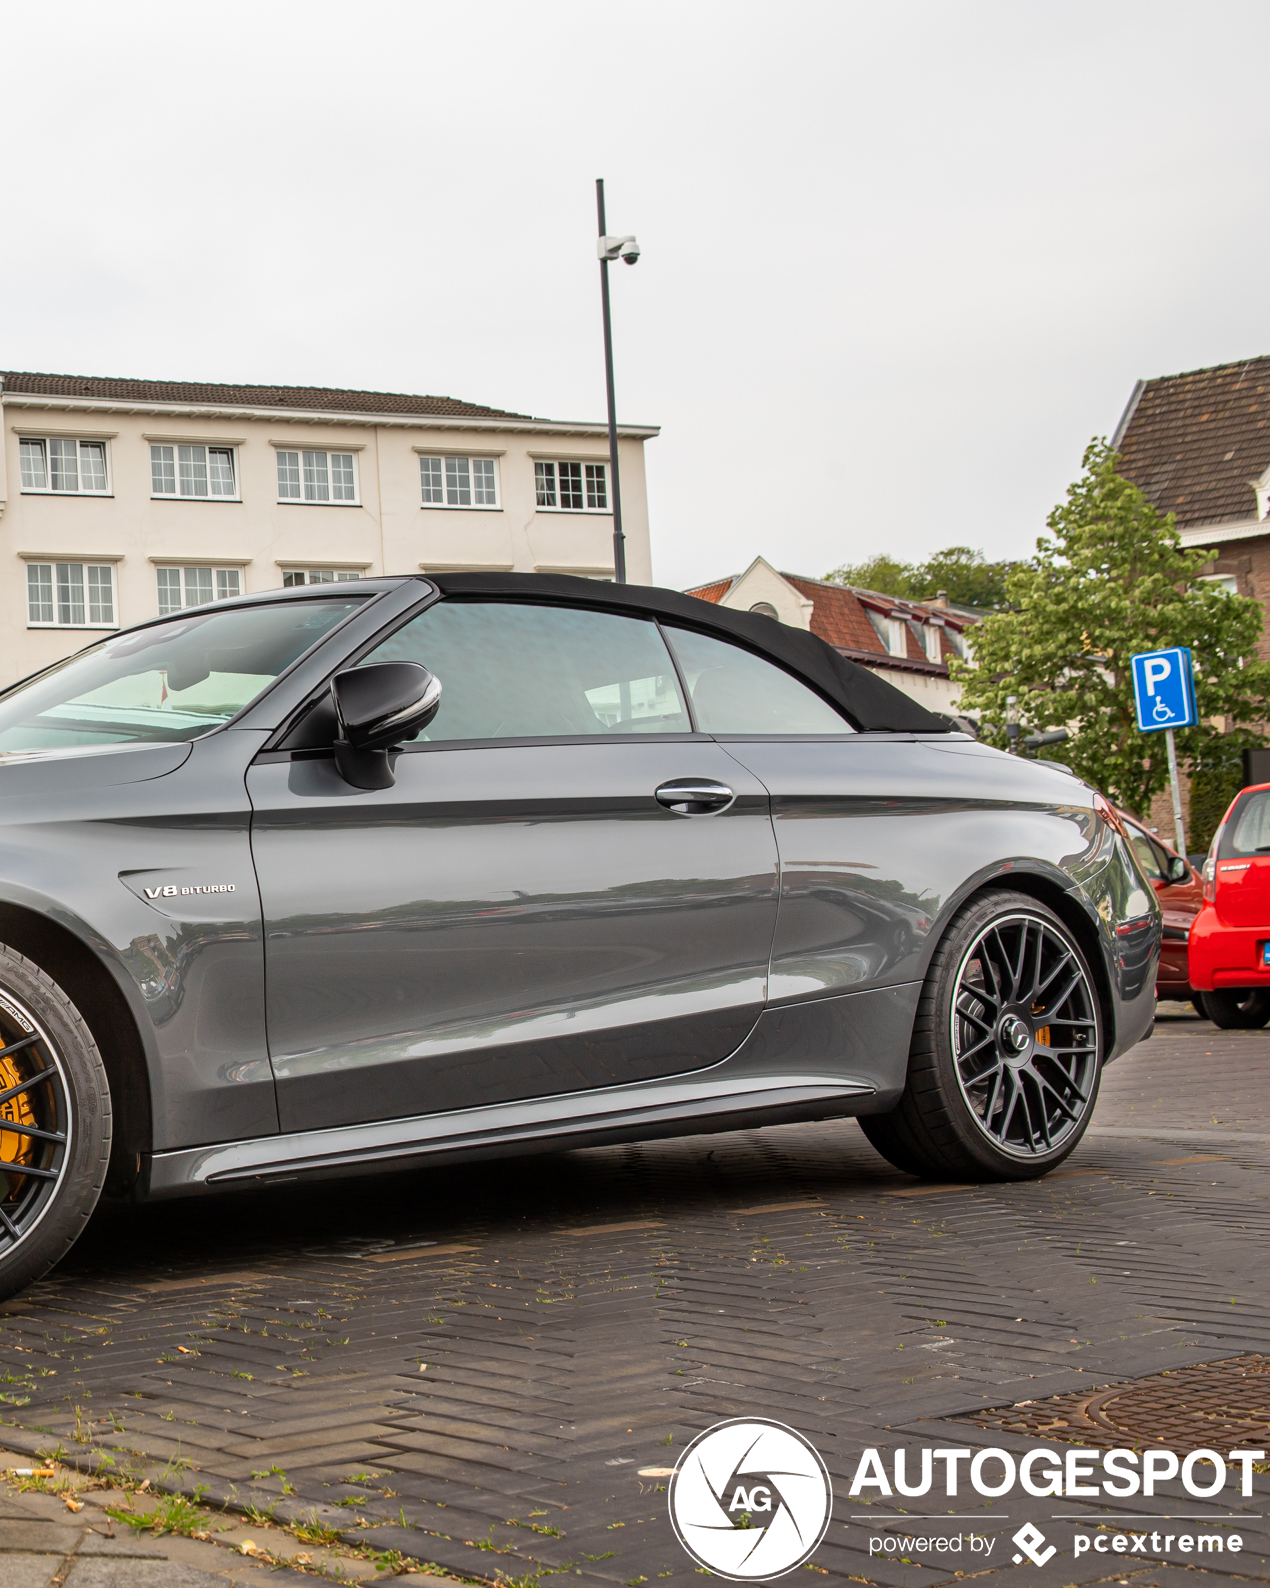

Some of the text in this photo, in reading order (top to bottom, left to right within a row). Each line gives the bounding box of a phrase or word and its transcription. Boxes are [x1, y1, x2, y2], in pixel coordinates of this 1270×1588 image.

[1144, 657, 1171, 696] P
[145, 884, 235, 898] V8 BITURBO
[3, 1005, 32, 1032] AMG
